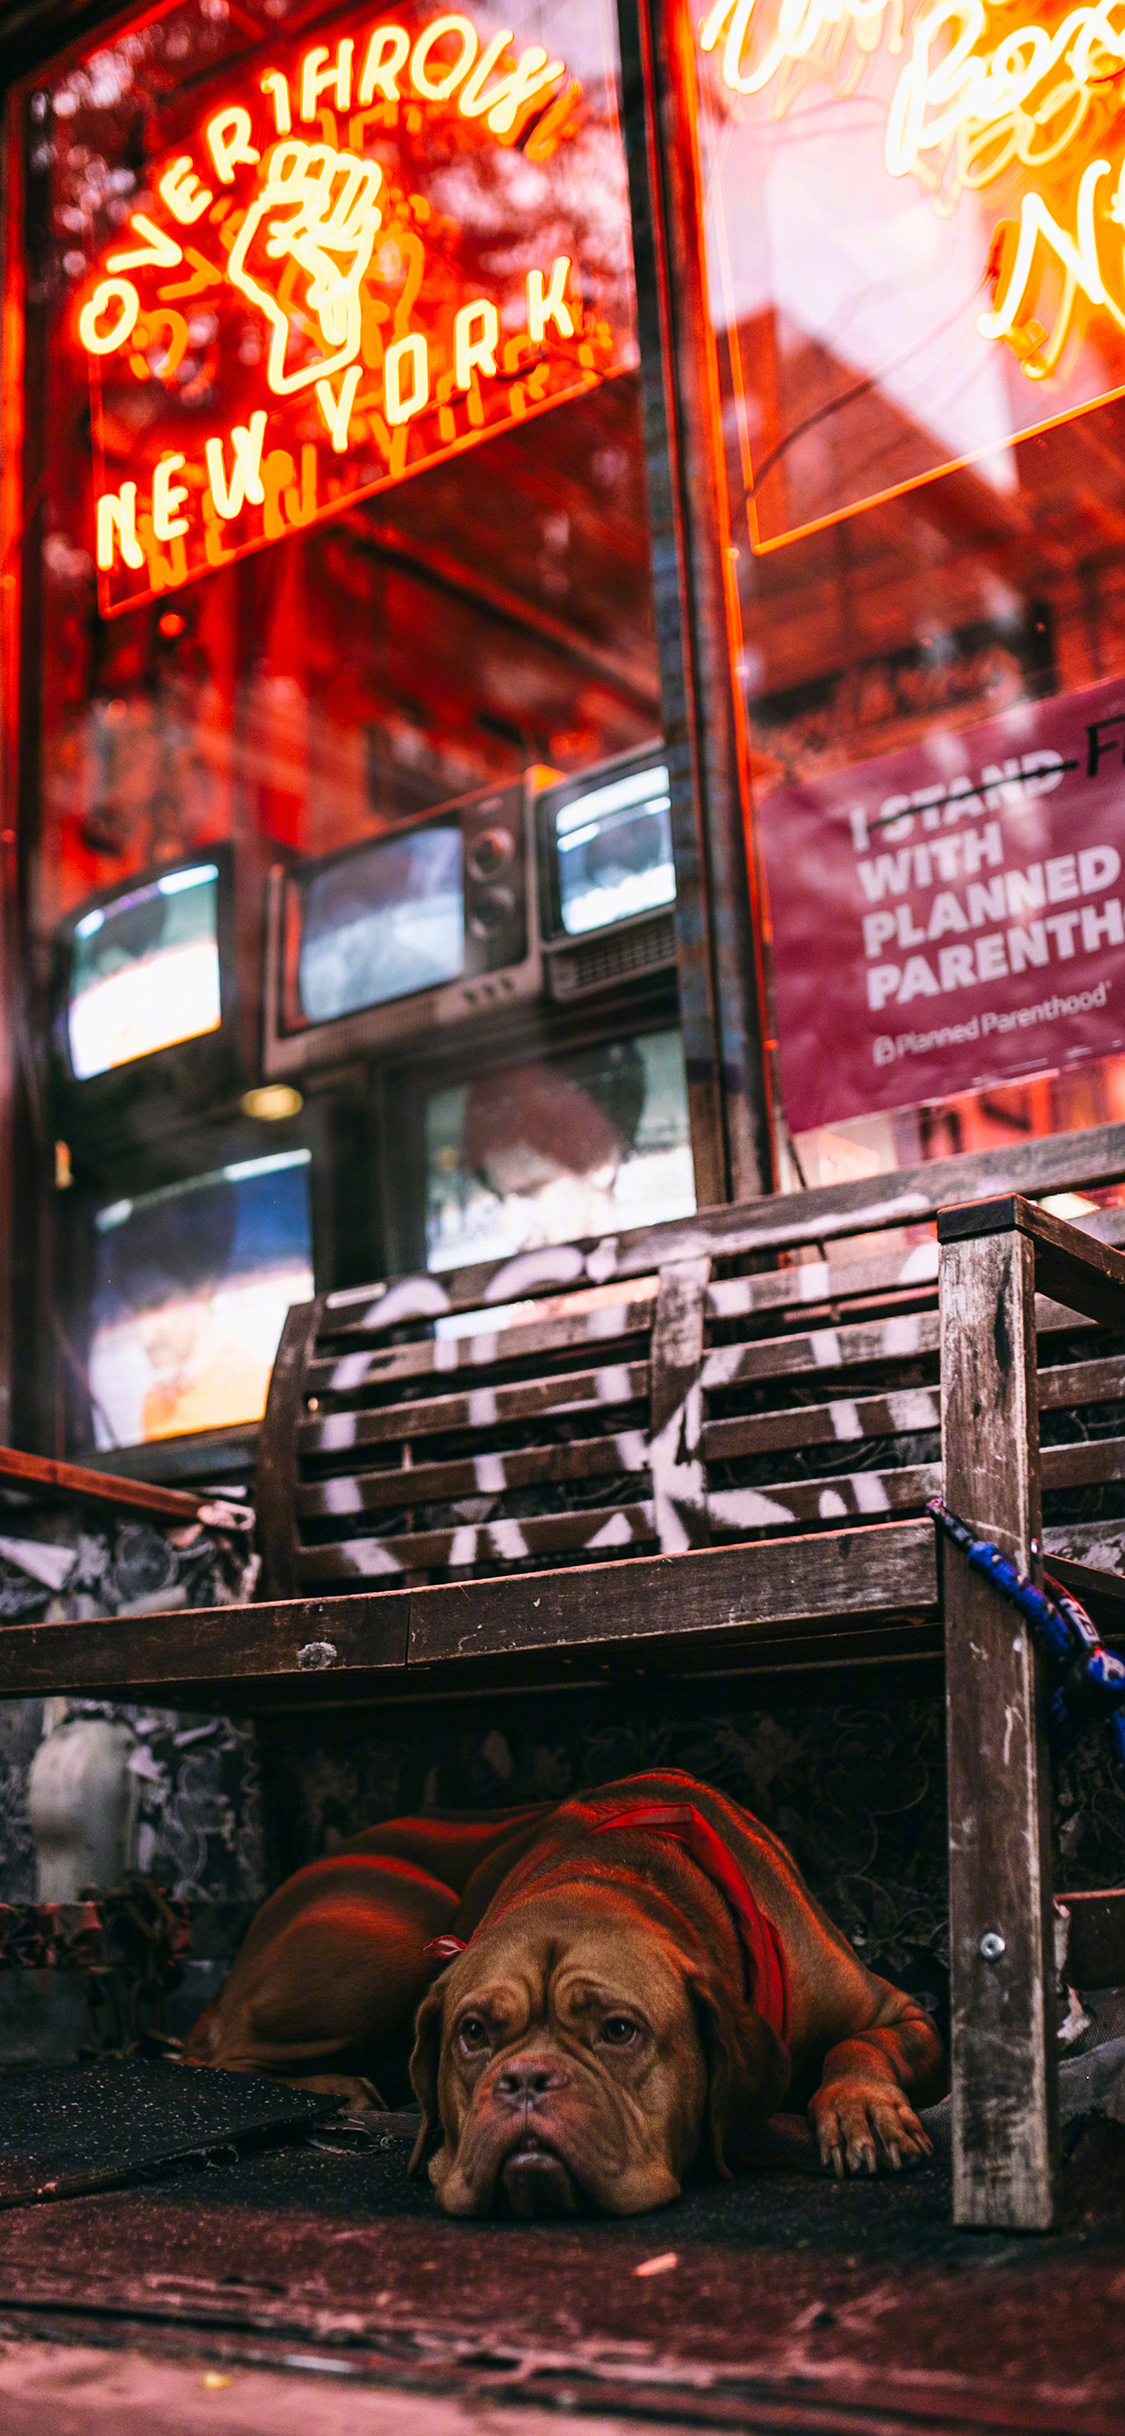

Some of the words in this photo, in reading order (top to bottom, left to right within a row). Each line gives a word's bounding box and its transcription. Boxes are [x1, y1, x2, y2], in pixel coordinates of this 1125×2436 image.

[80, 15, 565, 354] OVERTHROW
[97, 410, 267, 570] NEW
[316, 256, 574, 452] YORK
[849, 807, 871, 853] I
[879, 749, 1065, 843] STAND
[856, 821, 1004, 901] WITH
[862, 845, 1121, 958] PLANNED
[867, 898, 1125, 1011] PARENTH
[896, 1015, 980, 1058] Planned
[981, 980, 1107, 1036] Parenthood
